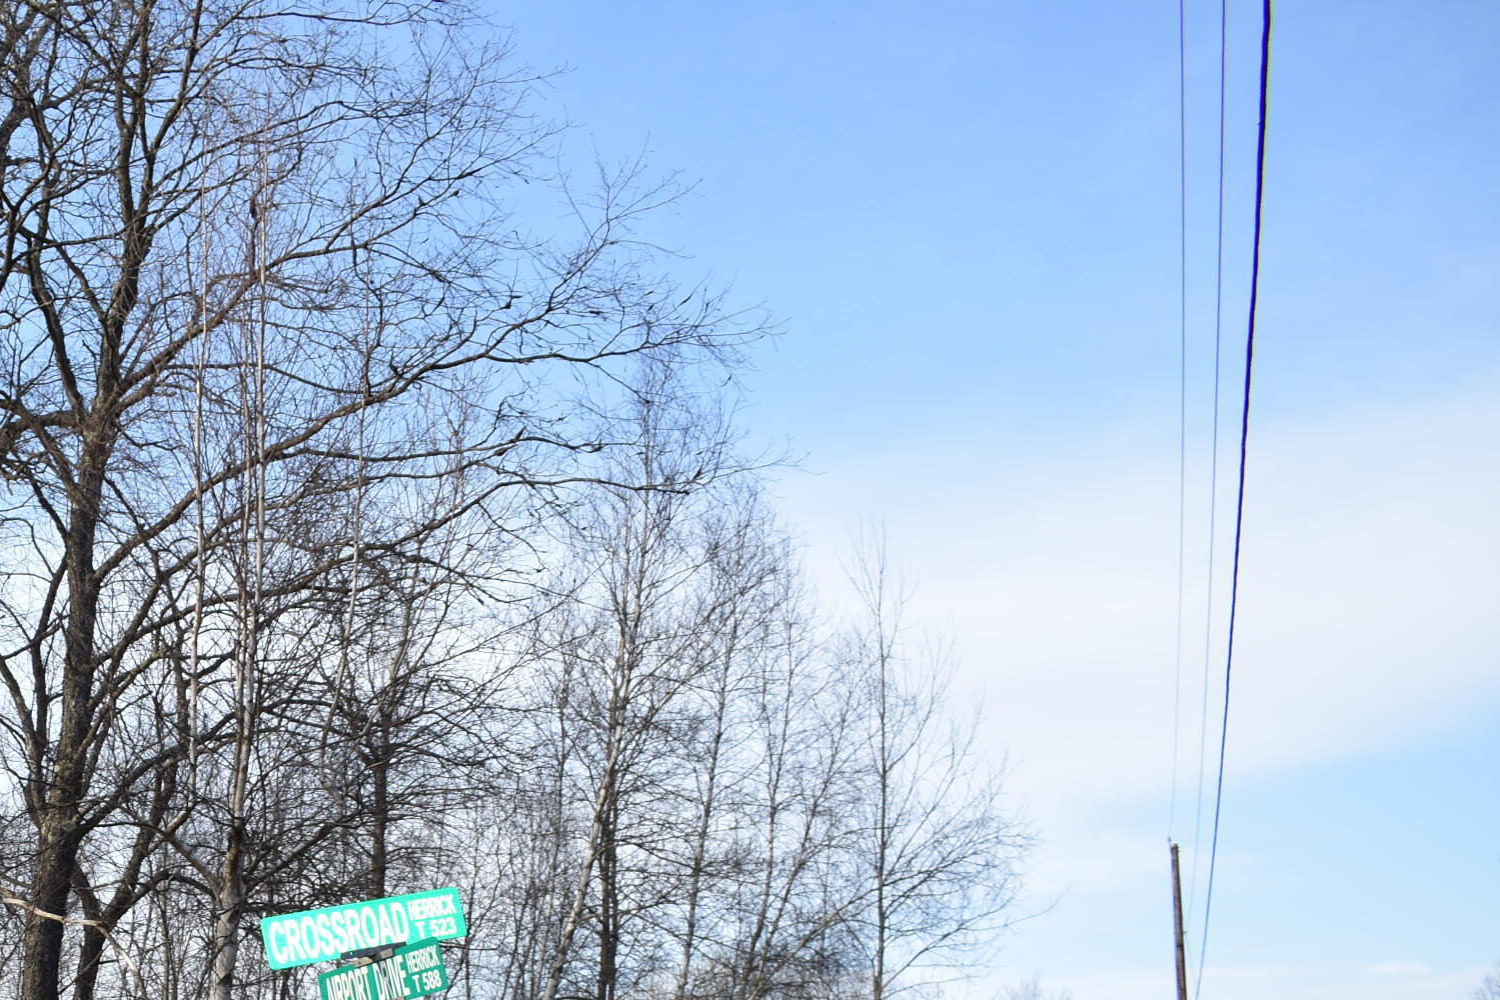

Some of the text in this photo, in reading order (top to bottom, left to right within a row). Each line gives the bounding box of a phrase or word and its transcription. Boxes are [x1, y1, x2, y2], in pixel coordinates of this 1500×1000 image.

[408, 895, 457, 921] HERRICK
[268, 902, 409, 964] CROSSROAD
[415, 918, 457, 938] T 523
[405, 945, 440, 974] HERRICK
[412, 969, 442, 993] T 588
